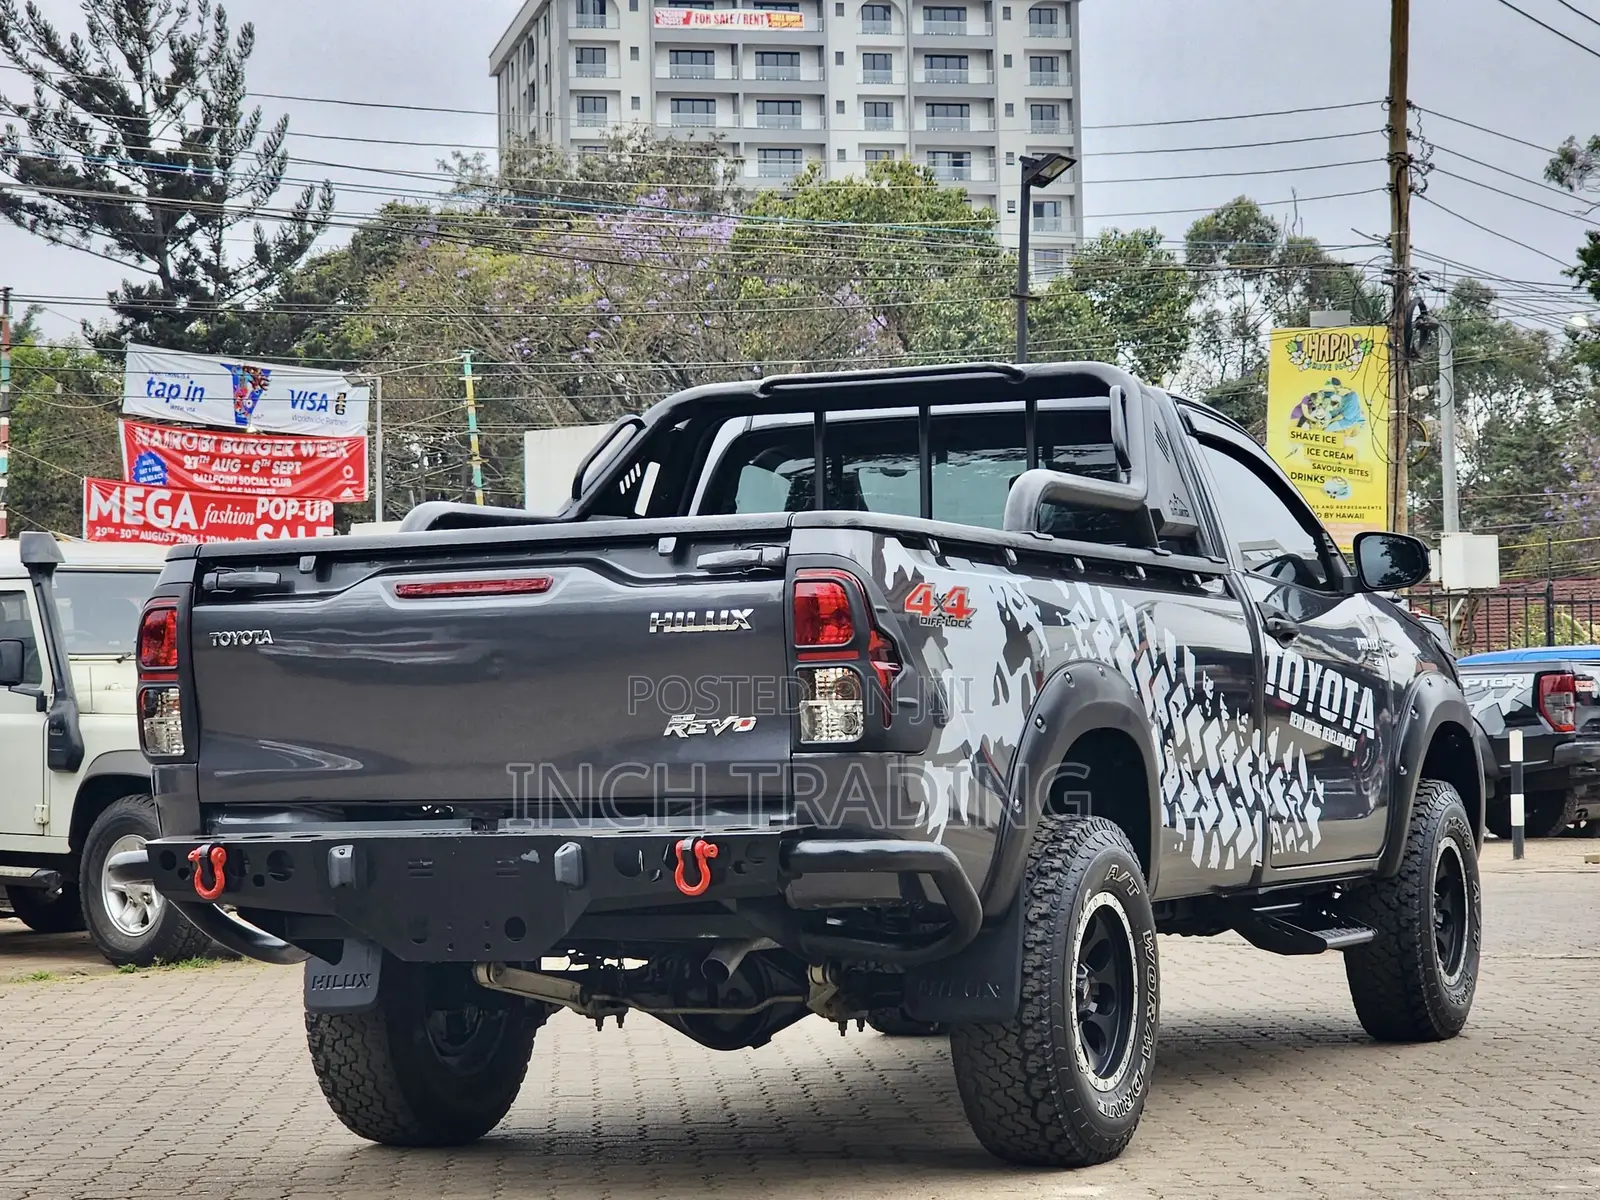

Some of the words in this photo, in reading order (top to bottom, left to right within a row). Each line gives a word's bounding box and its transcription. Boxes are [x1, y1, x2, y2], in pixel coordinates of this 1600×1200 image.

[694, 13, 710, 24] FOR
[713, 13, 734, 25] SALE
[743, 14, 765, 25] RENT
[1308, 332, 1350, 362] HAPA
[146, 377, 181, 404] tap
[183, 380, 205, 403] in
[287, 389, 328, 412] VISA
[135, 426, 217, 453] NAIROBI
[220, 437, 297, 457] BURGER
[300, 439, 350, 458] WEEK
[1290, 431, 1320, 442] SHAVE
[1322, 435, 1337, 444] ICE
[1306, 447, 1321, 457] ICE
[1323, 450, 1354, 461] CREAM
[211, 458, 242, 472] AUG
[251, 458, 271, 474] 6TH
[271, 461, 302, 475] SEPT
[1312, 462, 1346, 474] SAVOURY
[1348, 468, 1370, 477] BITES
[1290, 471, 1326, 484] DRINKS
[88, 482, 199, 531] MEGA
[200, 502, 256, 530] fashion
[256, 496, 334, 522] POP-UP
[95, 526, 115, 537] 29TH
[139, 530, 176, 542] AUGUST
[649, 608, 755, 633] HILUX
[920, 616, 973, 630] DIFF-LOCK
[208, 629, 274, 647] TOYOTA
[1264, 650, 1375, 740] TOYOTA
[1104, 864, 1141, 897] A/T
[311, 972, 372, 991] HILUX
